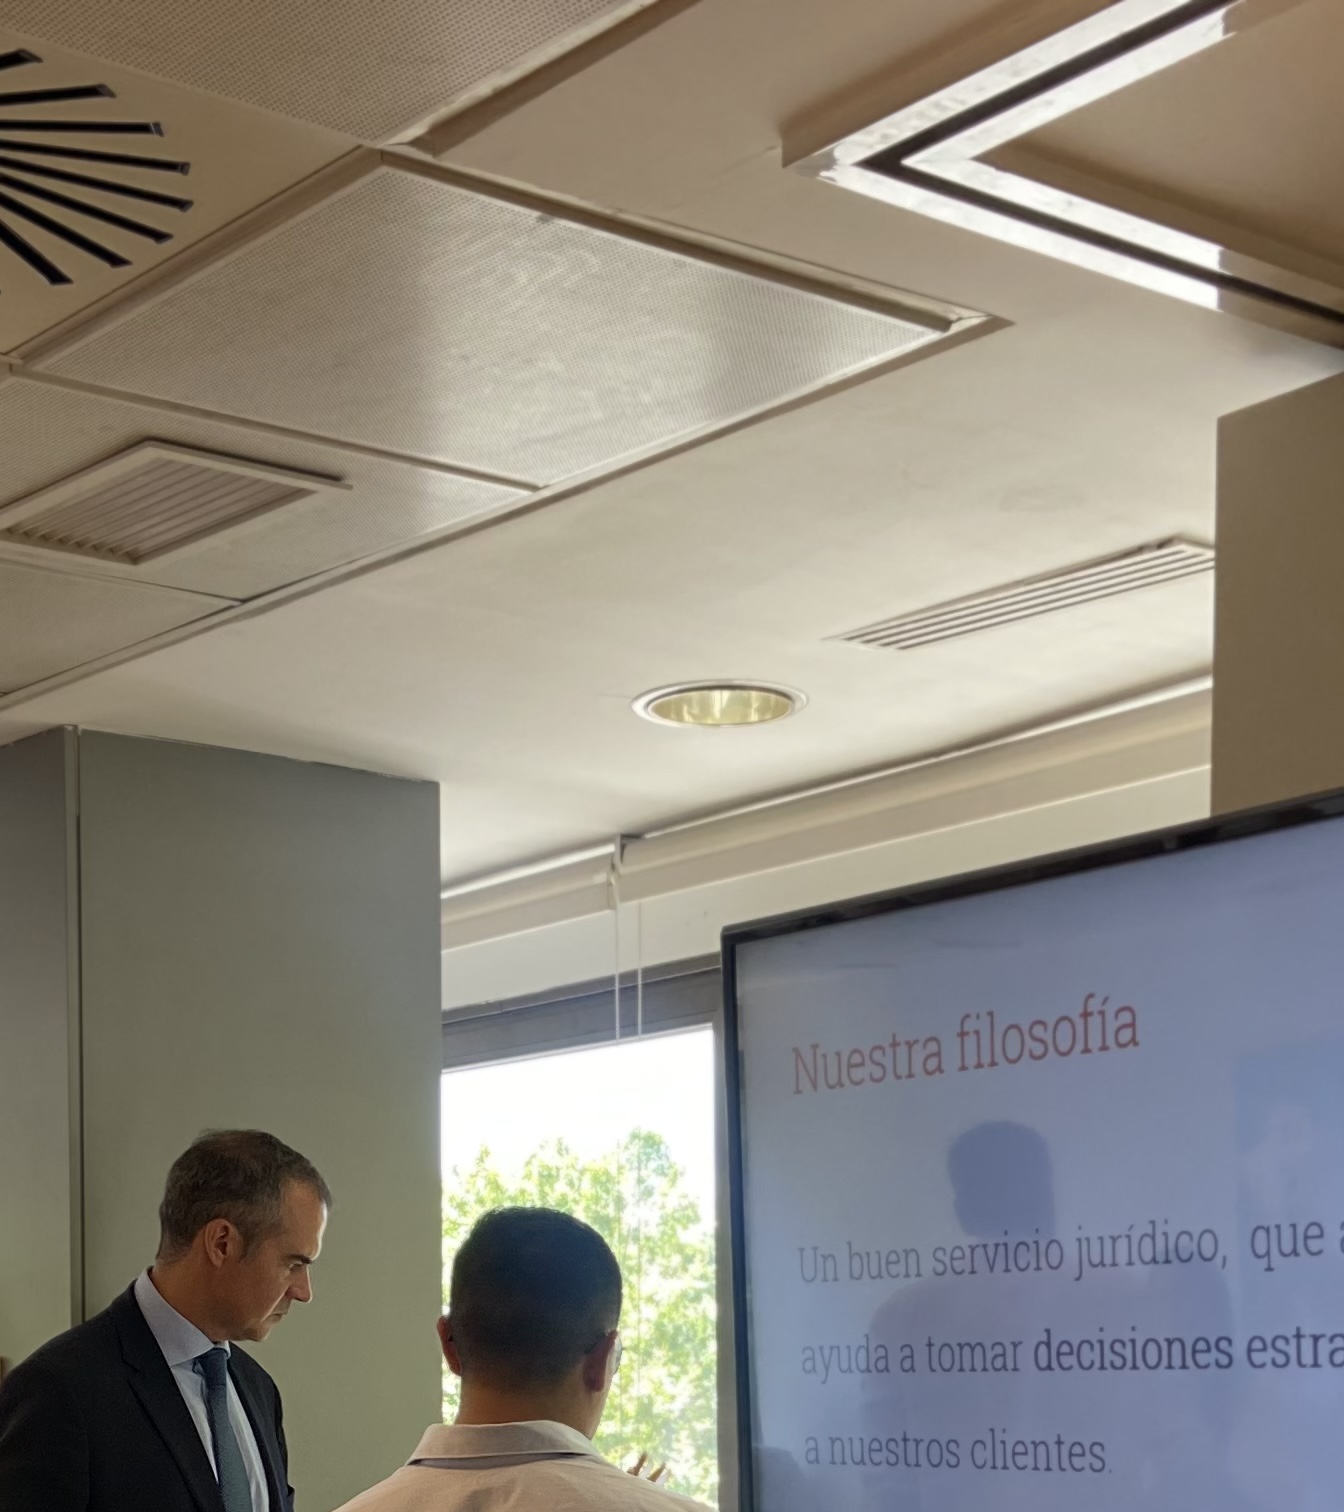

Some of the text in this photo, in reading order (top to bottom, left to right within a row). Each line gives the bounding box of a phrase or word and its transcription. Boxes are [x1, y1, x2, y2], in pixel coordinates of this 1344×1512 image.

[792, 993, 1140, 1095] Nuestra filosofía
[797, 1244, 840, 1284] Un
[847, 1240, 923, 1283] buen
[931, 1228, 1065, 1277] servicio
[1072, 1218, 1230, 1283] jurídico,
[1249, 1216, 1325, 1273] que
[801, 1332, 892, 1386] ayuda
[898, 1342, 918, 1375] a
[925, 1332, 1024, 1374] tomar
[1033, 1325, 1235, 1373] decisiones
[804, 1433, 822, 1466] a
[828, 1429, 962, 1469] nuestros
